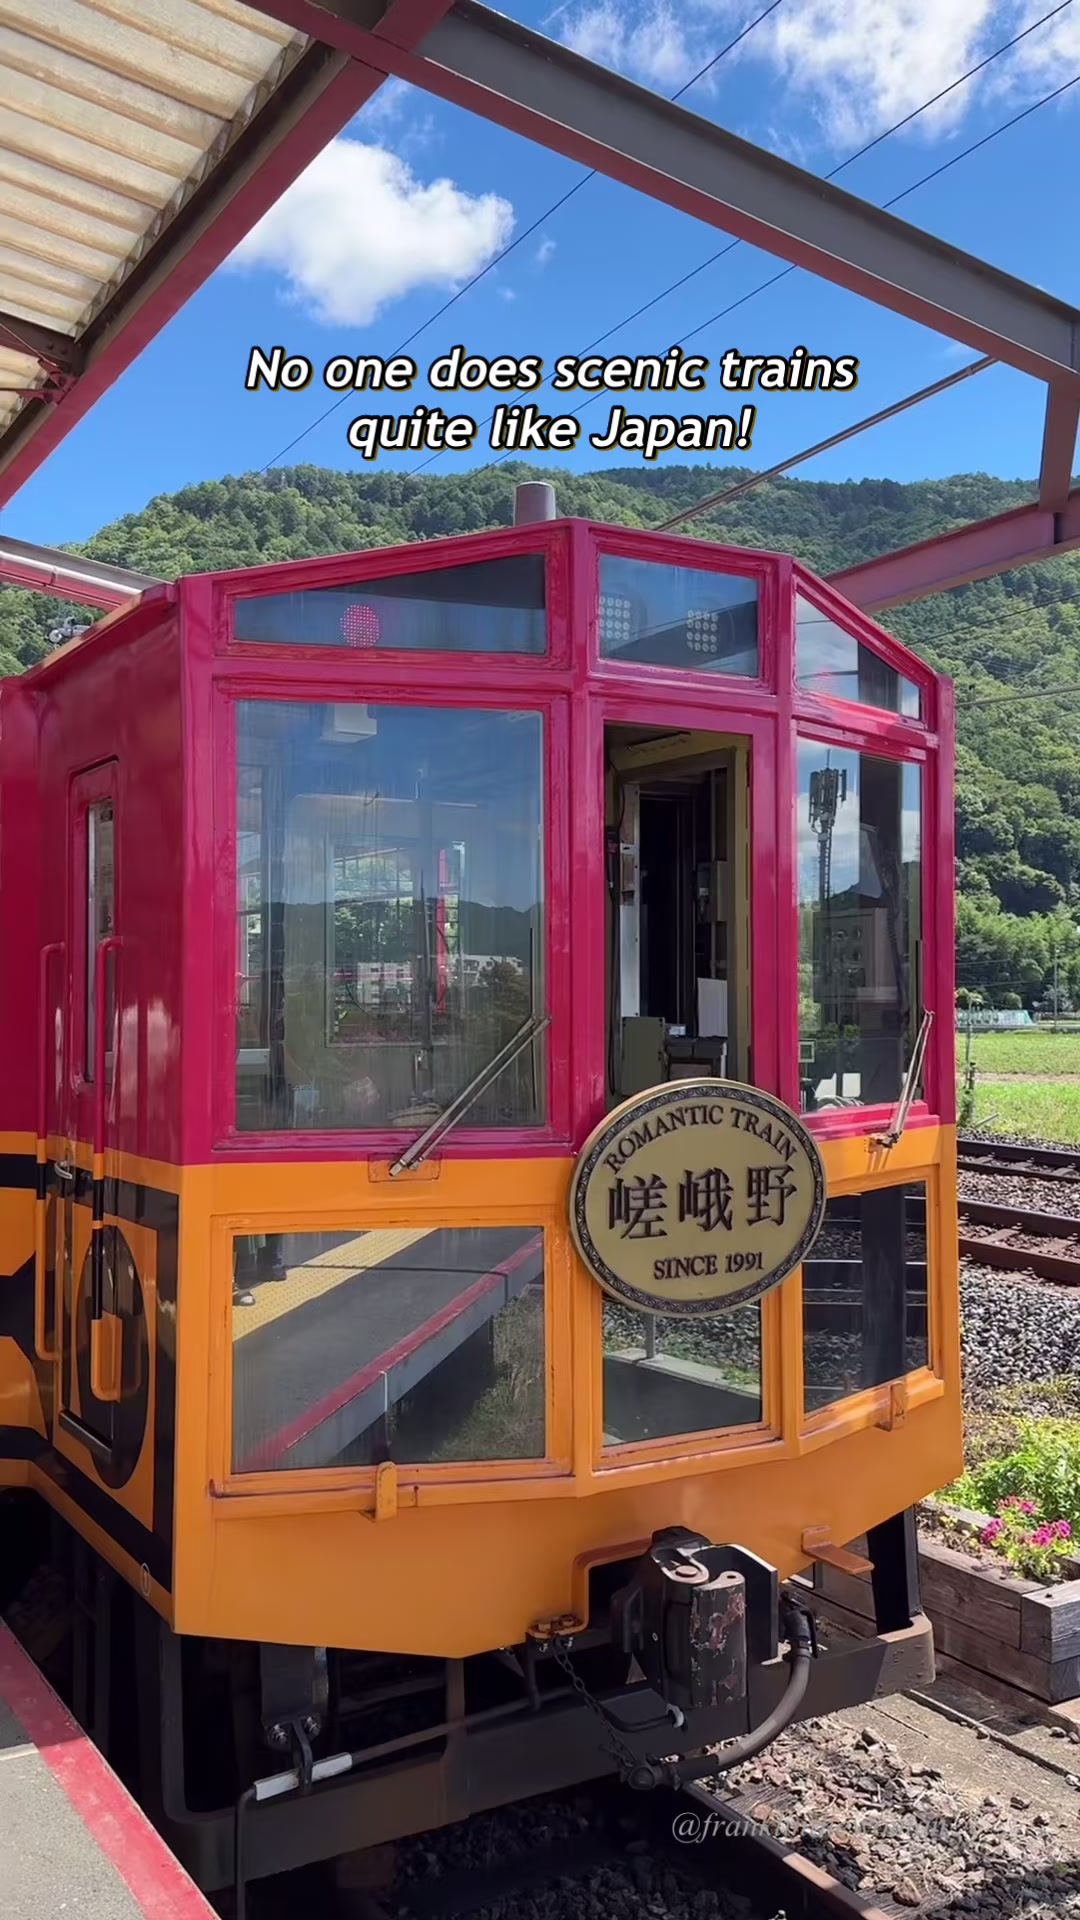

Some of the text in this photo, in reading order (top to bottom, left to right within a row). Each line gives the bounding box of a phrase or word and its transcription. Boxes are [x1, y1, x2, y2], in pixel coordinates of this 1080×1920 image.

[603, 1105, 798, 1174] ROMANTIC TRAIN
[608, 1164, 798, 1240] 嵯峨野
[653, 1252, 764, 1281] SINCE 1991
